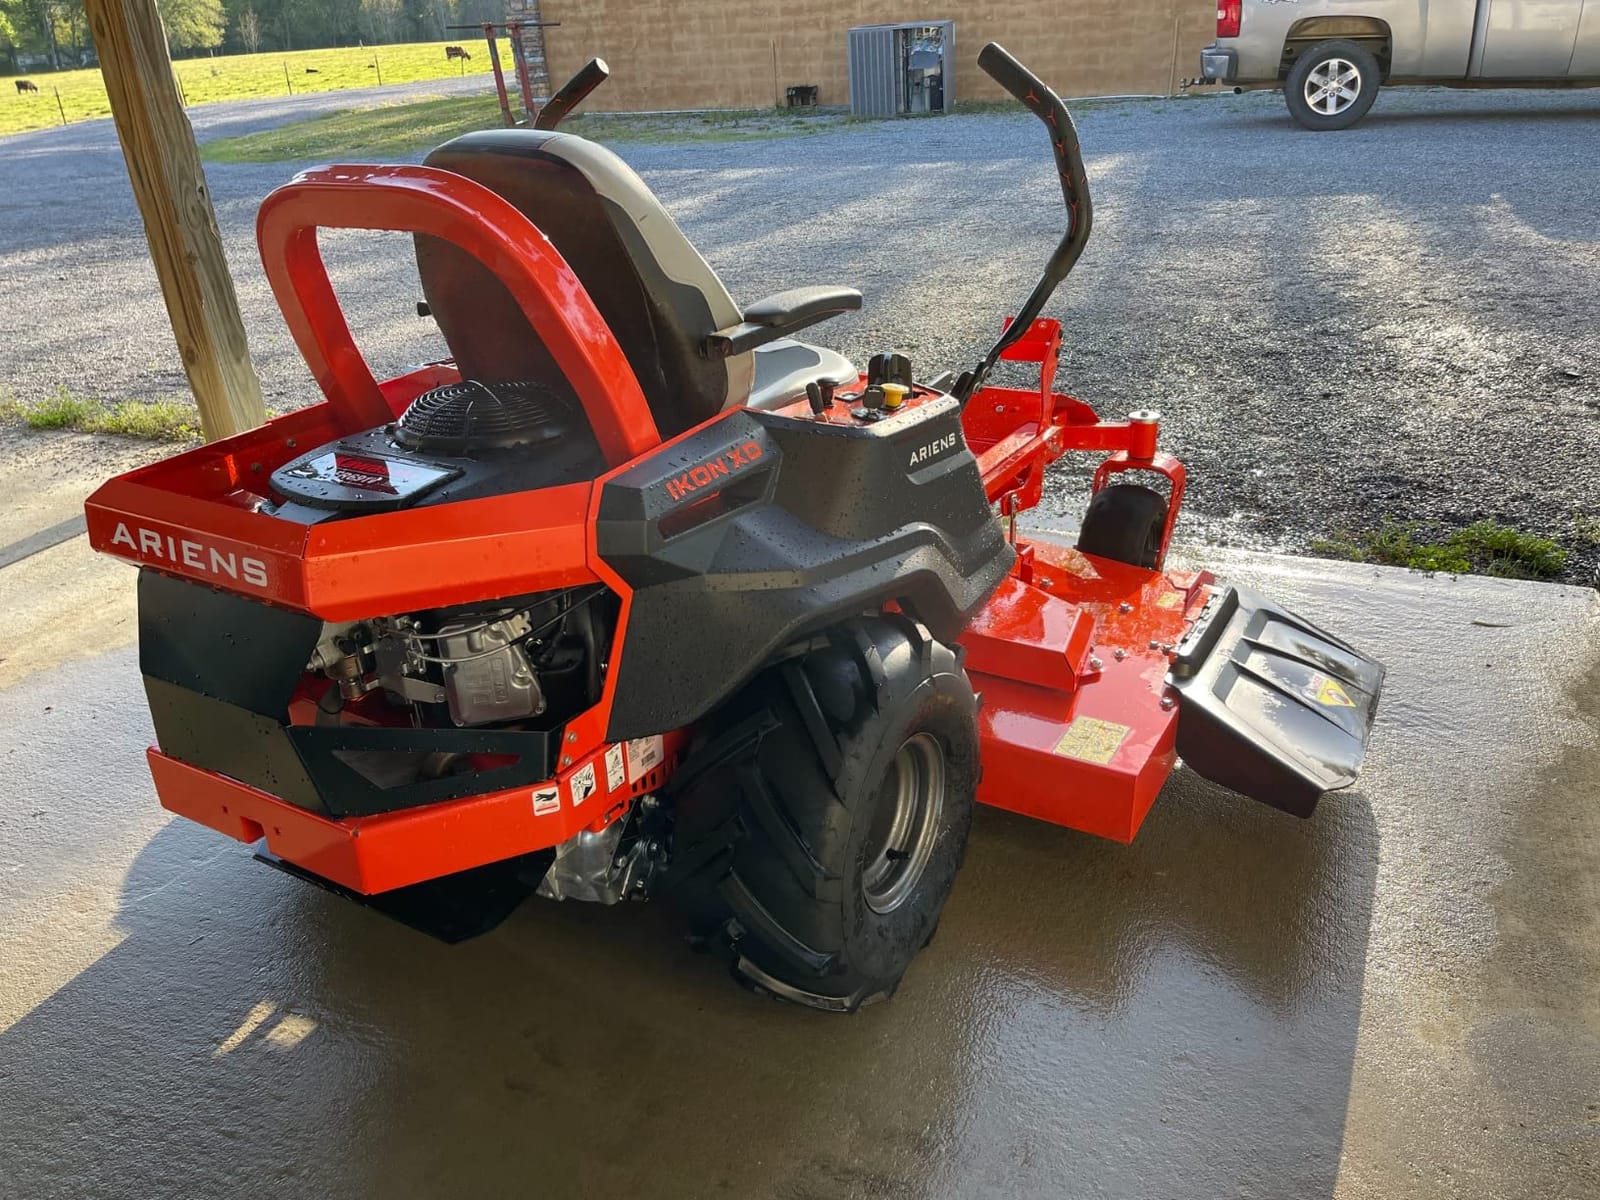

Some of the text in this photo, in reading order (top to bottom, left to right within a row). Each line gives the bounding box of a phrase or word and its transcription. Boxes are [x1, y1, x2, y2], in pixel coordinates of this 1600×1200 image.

[909, 432, 956, 467] ARIENS
[664, 457, 729, 501] IKON
[111, 522, 268, 588] ARIENS
